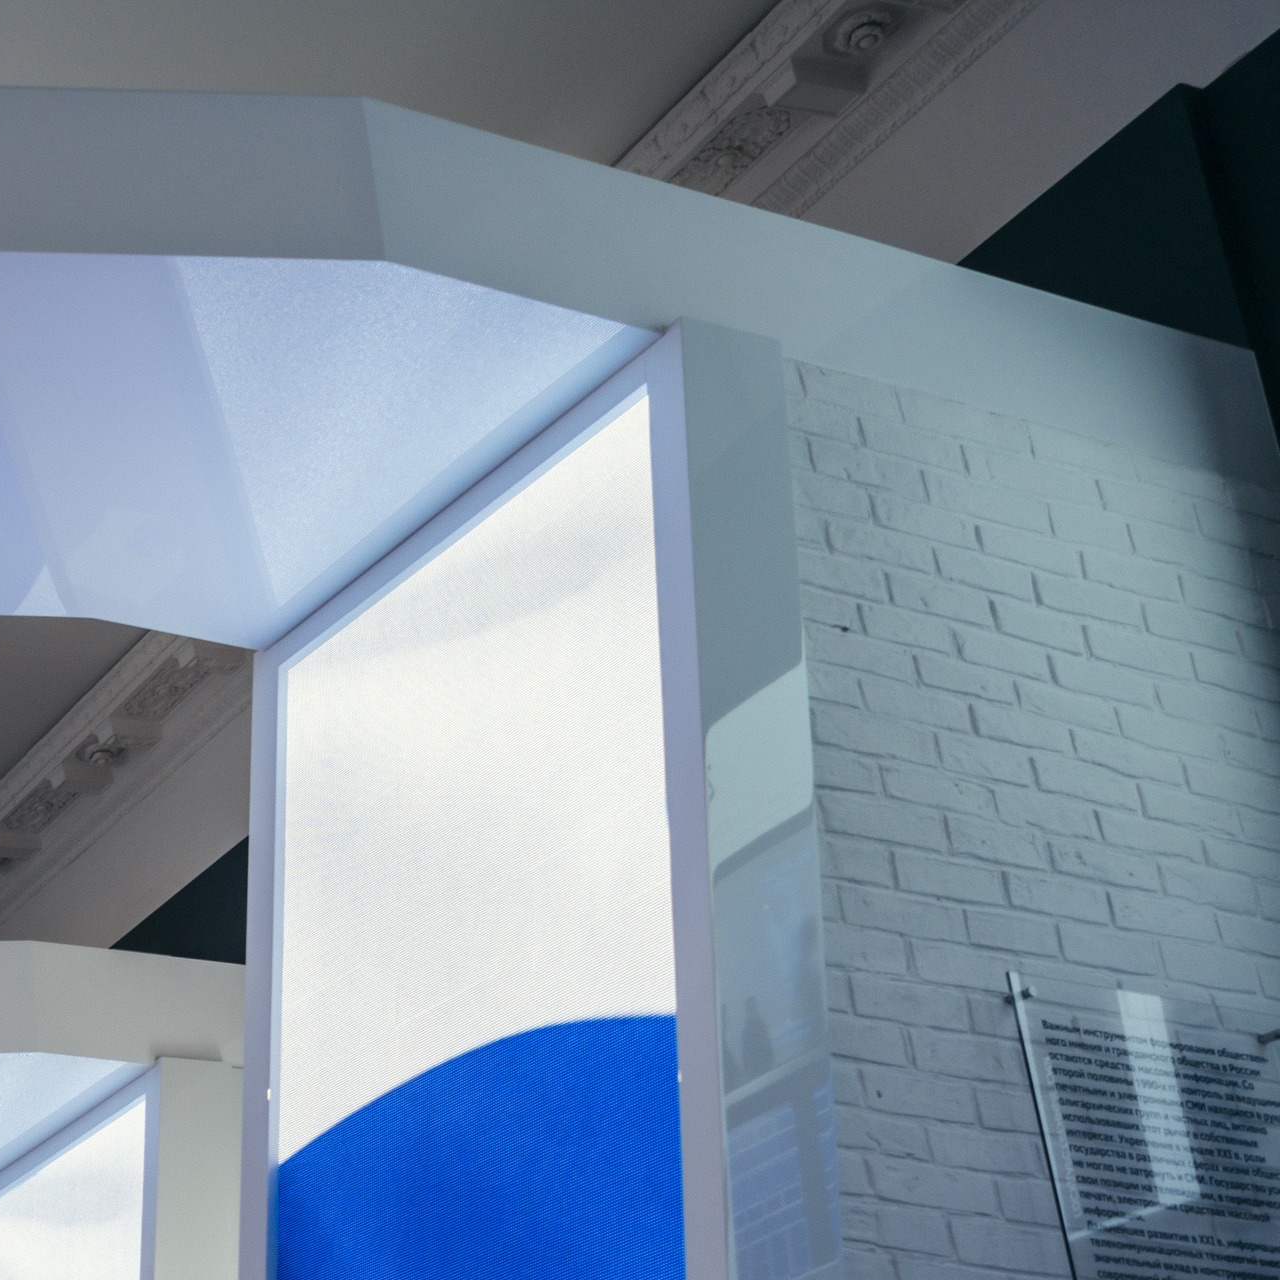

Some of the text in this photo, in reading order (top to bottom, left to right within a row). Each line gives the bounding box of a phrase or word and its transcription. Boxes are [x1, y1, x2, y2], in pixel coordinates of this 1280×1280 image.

[1041, 1018, 1081, 1034] Важным
[1082, 1027, 1147, 1045] инструментом
[1217, 1047, 1268, 1063] обществен-
[1044, 1036, 1067, 1046] ного
[1068, 1039, 1102, 1052] мнения
[1176, 1055, 1219, 1070] общества
[1228, 1062, 1259, 1076] России
[1048, 1051, 1092, 1065] остаются
[1093, 1058, 1135, 1071] средства
[1182, 1070, 1239, 1087] информации.
[1051, 1066, 1085, 1079] второй
[1086, 1071, 1134, 1086] половины
[1135, 1076, 1166, 1091] 1990-х
[1177, 1085, 1222, 1099] контроль
[1054, 1081, 1107, 1097] печатными
[1207, 1104, 1254, 1118] находился
[1058, 1097, 1133, 1115] олигархических
[1134, 1108, 1161, 1120] групп
[1210, 1119, 1229, 1130] лиц,
[1231, 1122, 1266, 1135] активно
[1061, 1112, 1140, 1130] использовавших
[1200, 1131, 1257, 1147] собственных
[1065, 1127, 1116, 1142] интересах.
[1182, 1144, 1215, 1156] начале
[1243, 1153, 1264, 1163] роли
[1068, 1142, 1126, 1158] государства
[1221, 1164, 1249, 1176] жизни
[1085, 1160, 1114, 1172] могло
[1209, 1175, 1265, 1193] Государство
[1075, 1174, 1098, 1185] свои
[1099, 1177, 1139, 1190] позиции
[1078, 1189, 1115, 1203] печати,
[1179, 1203, 1225, 1217] средствах
[1227, 1210, 1269, 1223] массовой
